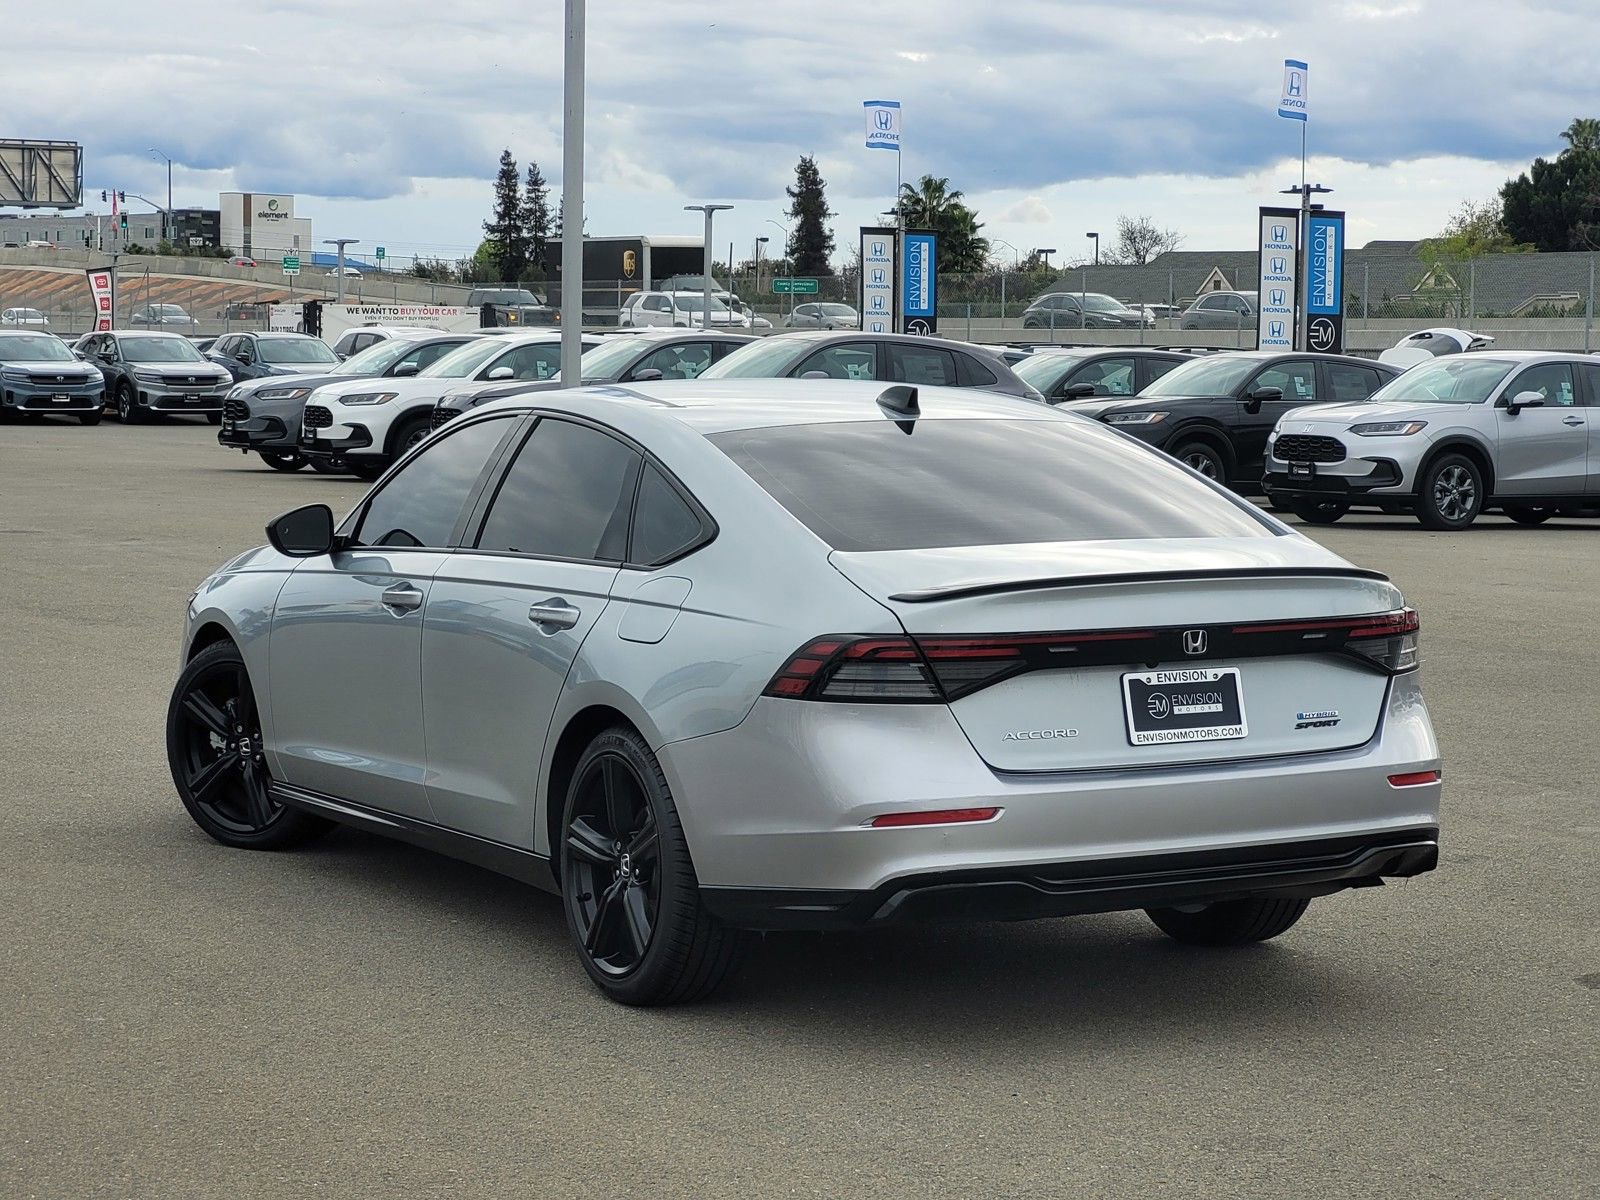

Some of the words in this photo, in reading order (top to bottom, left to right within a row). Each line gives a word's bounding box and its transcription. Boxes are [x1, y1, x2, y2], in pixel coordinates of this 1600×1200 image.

[258, 211, 288, 219] element
[1313, 225, 1326, 306] ENVISION
[910, 241, 920, 310] ENVISION
[1156, 670, 1208, 682] ENVISION
[1172, 692, 1222, 705] ENVISION
[1294, 719, 1341, 730] SPORT
[1002, 728, 1078, 741] ACCORD
[1137, 728, 1243, 742] ENVISIONMOTORS.COM
